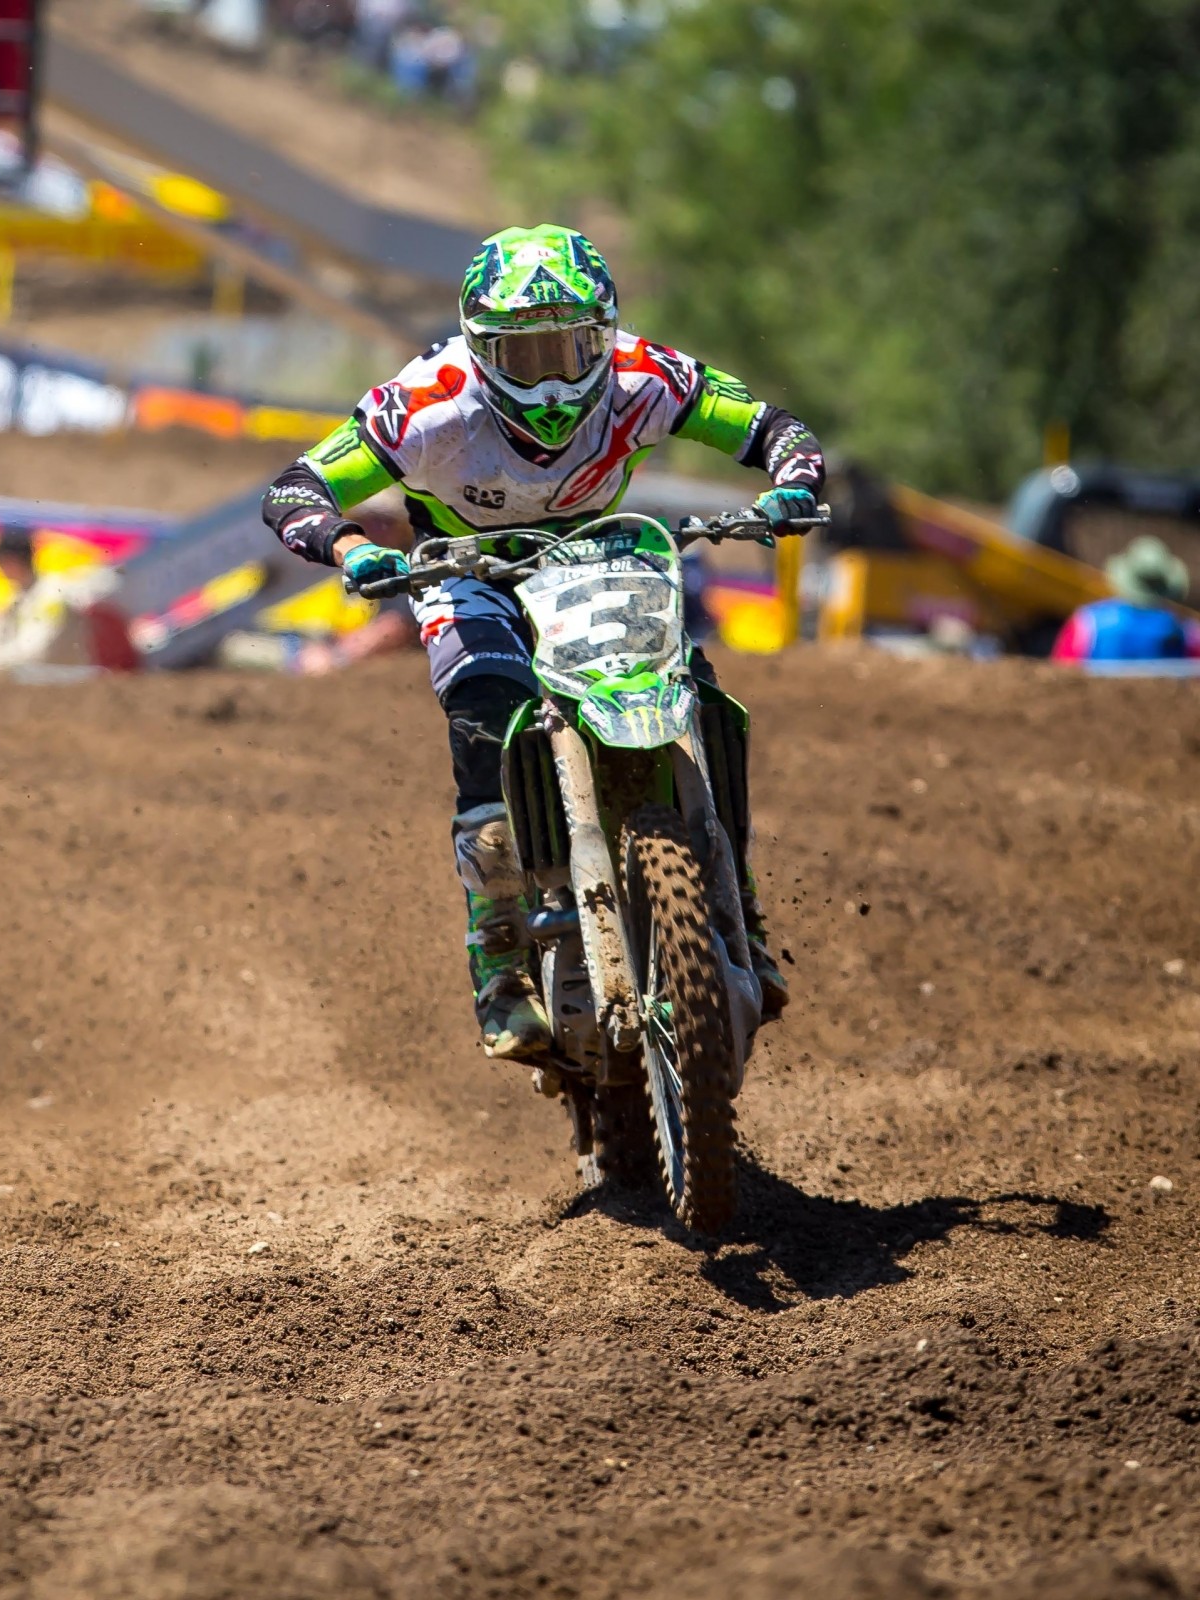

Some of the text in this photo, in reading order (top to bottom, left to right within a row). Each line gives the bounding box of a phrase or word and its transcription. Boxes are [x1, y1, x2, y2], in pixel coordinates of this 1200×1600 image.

[464, 487, 504, 505] PPG
[610, 560, 634, 572] OIL
[553, 577, 671, 671] 3
